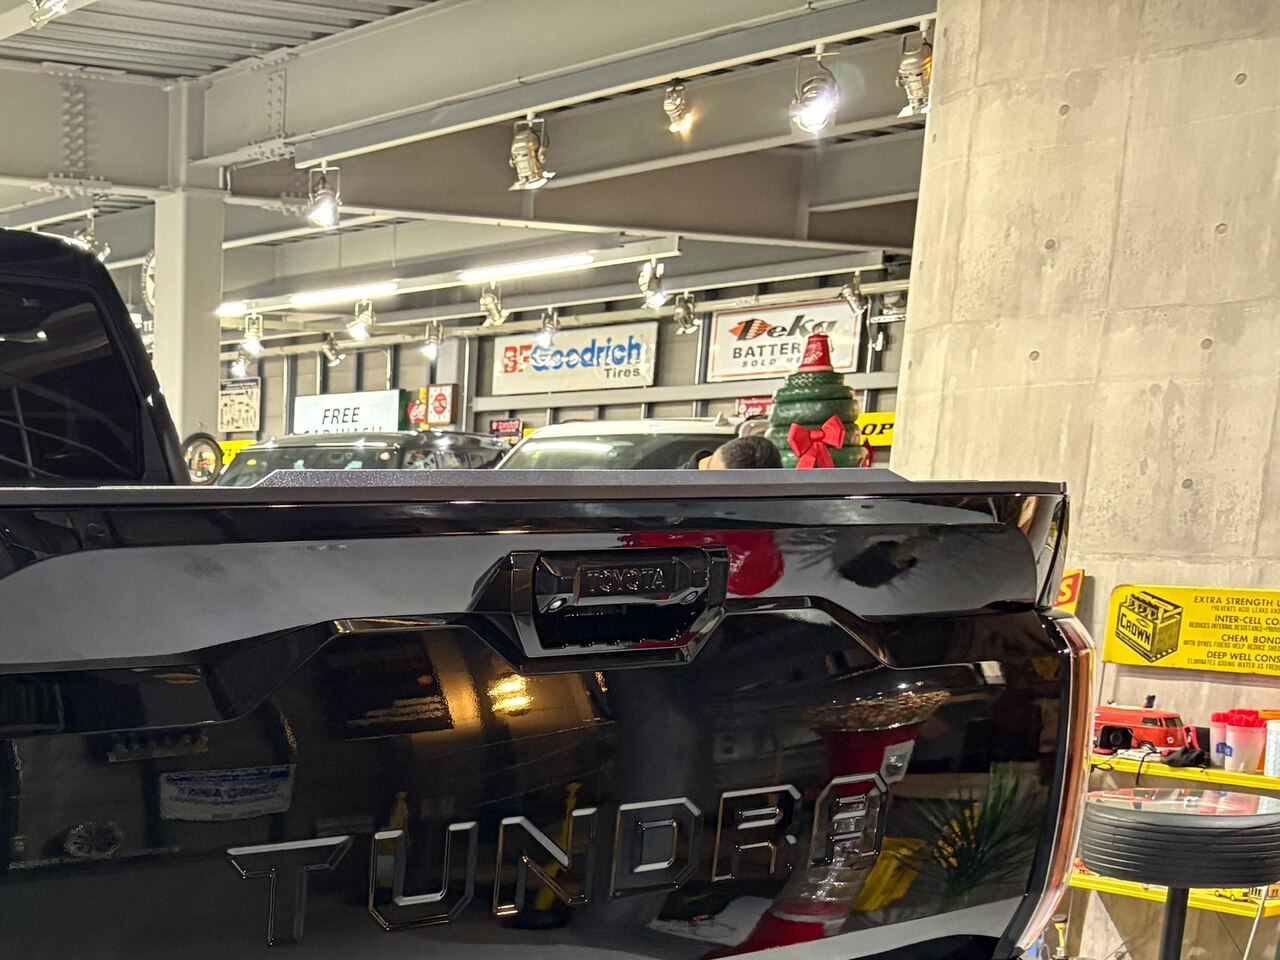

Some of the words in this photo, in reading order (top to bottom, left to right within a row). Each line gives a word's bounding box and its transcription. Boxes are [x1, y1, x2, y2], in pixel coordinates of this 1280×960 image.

[503, 335, 642, 374] BFGoodrich
[732, 342, 802, 359] BATTER
[742, 358, 777, 368] SOLD
[604, 367, 641, 379] Tires
[321, 407, 361, 425] FREE
[586, 567, 666, 592] TOYOTA
[1194, 595, 1222, 604] EXTRA
[1225, 597, 1273, 607] STRENGTH
[1214, 615, 1262, 625] INTER-CELL
[1120, 612, 1151, 646] CROWN
[1221, 634, 1248, 643] CHEM
[1207, 650, 1227, 659] DEEP
[1230, 652, 1252, 661] WELL
[225, 772, 889, 945] TUNDRA
